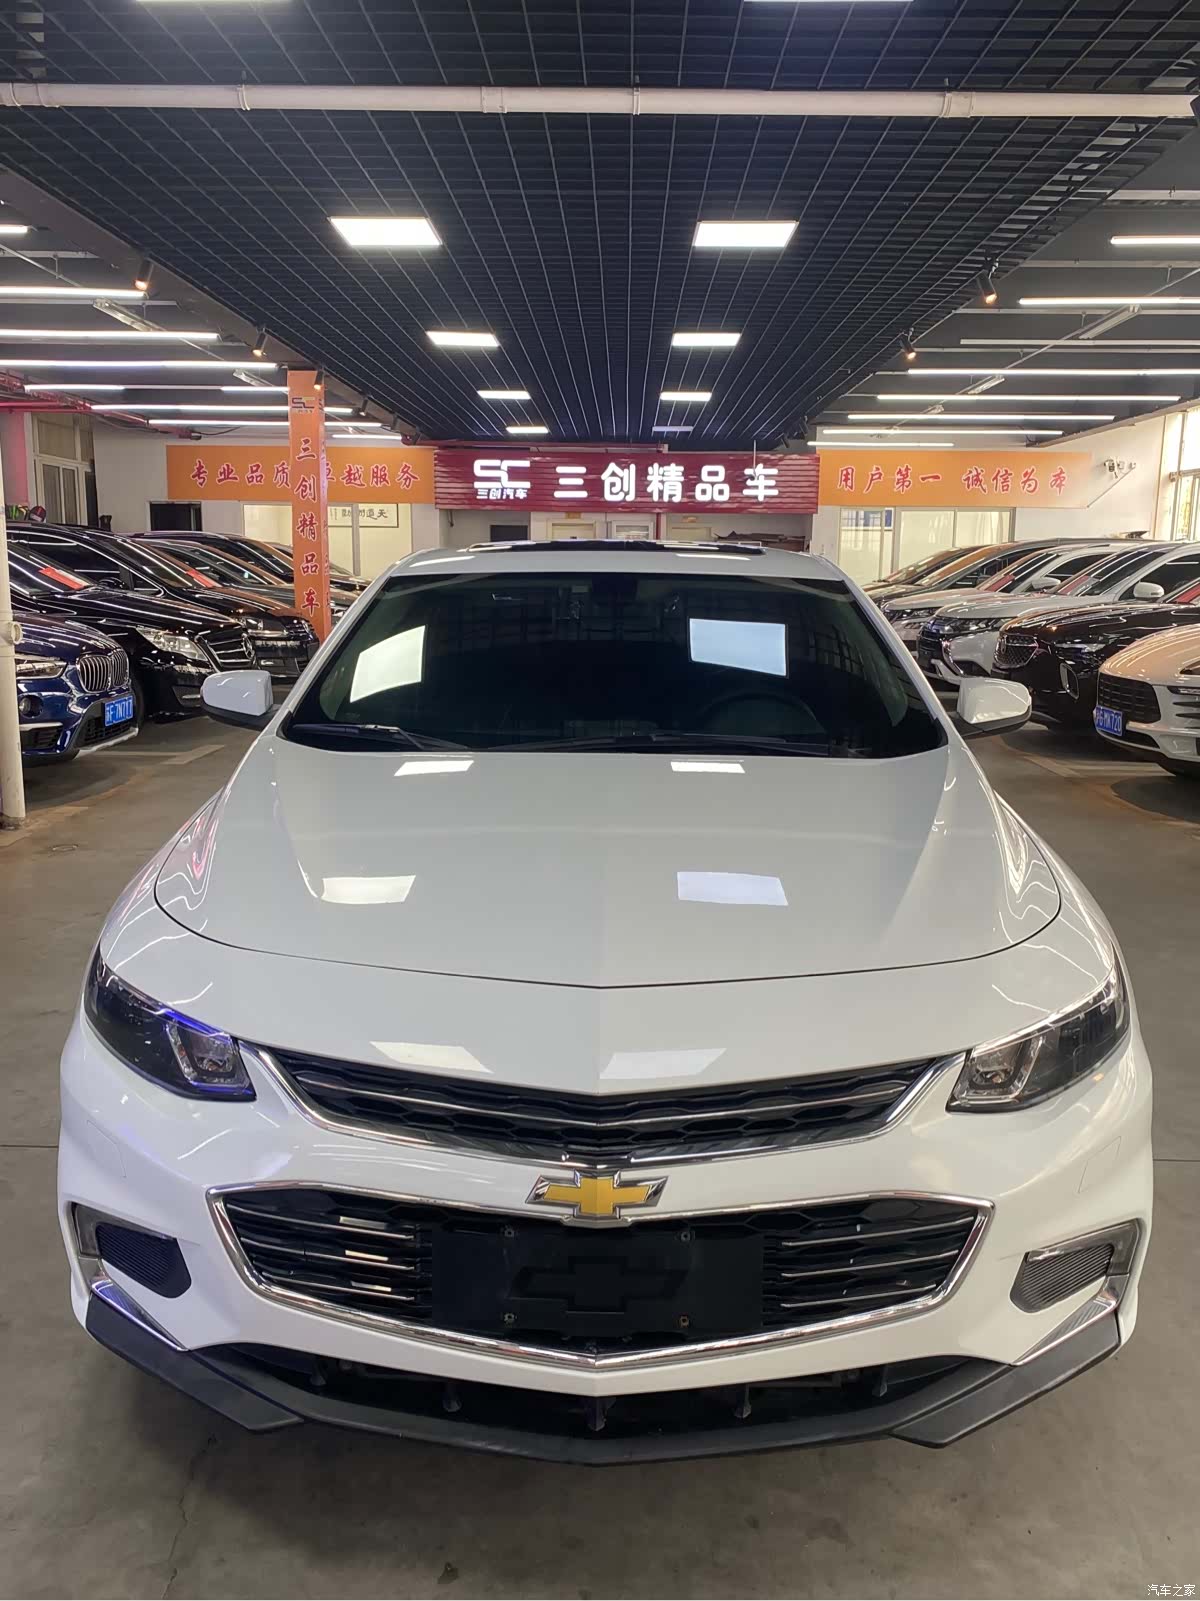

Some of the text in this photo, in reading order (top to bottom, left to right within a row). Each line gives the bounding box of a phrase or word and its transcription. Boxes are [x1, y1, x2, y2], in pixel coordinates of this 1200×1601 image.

[190, 459, 292, 489] 专业品质
[473, 459, 531, 489] SC
[553, 462, 779, 503] 三创精品车
[837, 464, 1068, 496] 用户第一 诚信为本
[476, 488, 528, 500] 三创汽车
[294, 438, 320, 616] 三创精品车
